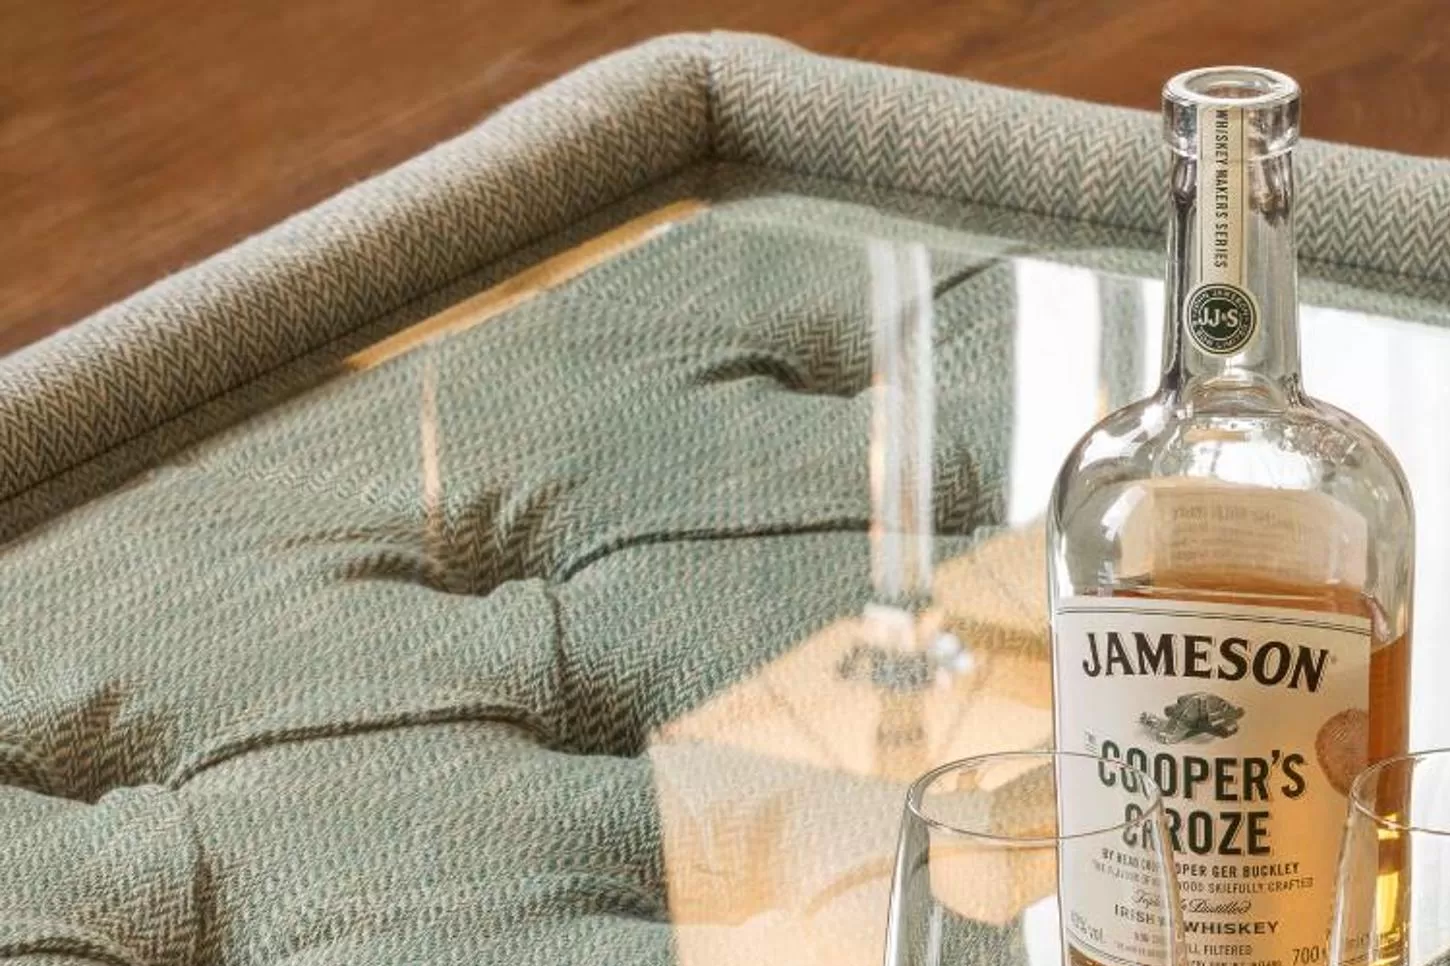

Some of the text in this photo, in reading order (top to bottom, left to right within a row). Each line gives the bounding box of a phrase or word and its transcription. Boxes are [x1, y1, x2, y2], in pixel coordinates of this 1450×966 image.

[1214, 109, 1229, 269] WHISKEY MAKERS SERIES
[1082, 631, 1329, 693] JAMESON
[1098, 739, 1307, 801] COOPER'S
[1211, 865, 1237, 878] GER
[1242, 862, 1300, 878] BUCKLEY
[1114, 903, 1155, 925] IRISH
[1184, 920, 1279, 935] WHISKEY
[1203, 945, 1252, 956] FILTERED
